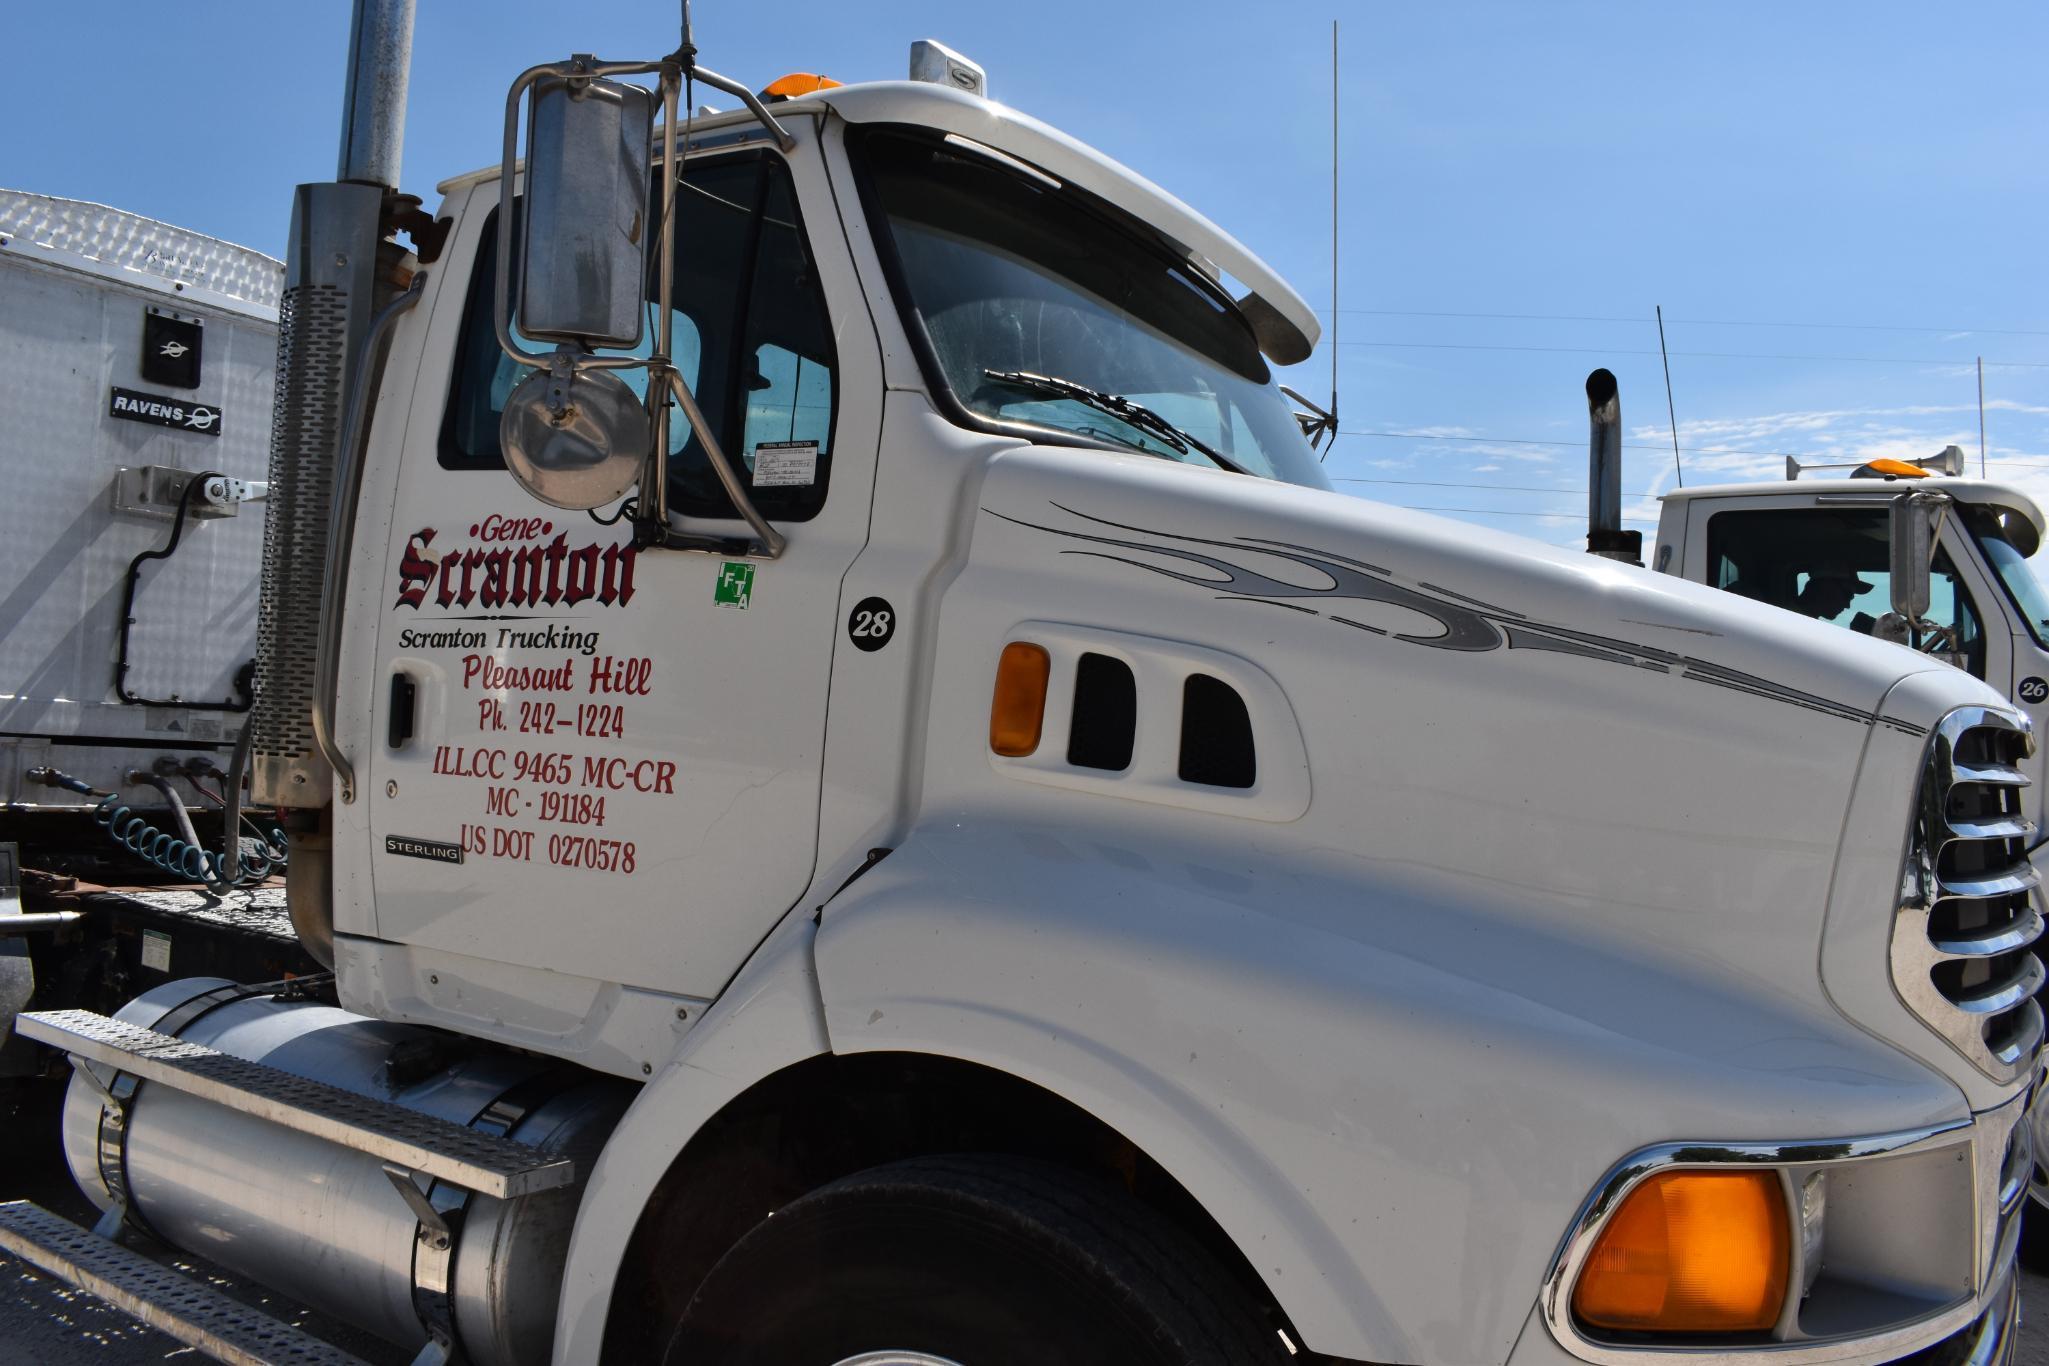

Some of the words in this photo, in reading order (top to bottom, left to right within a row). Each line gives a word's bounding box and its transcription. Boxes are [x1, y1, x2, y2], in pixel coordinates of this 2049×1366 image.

[114, 396, 184, 421] RAVENS
[480, 514, 544, 543] Gene
[393, 527, 641, 611] Scranton
[399, 627, 487, 649] Scranton
[497, 624, 600, 656] Trucking
[852, 610, 891, 638] 28
[462, 654, 574, 692] Pleasant
[589, 656, 652, 695] Hill
[2021, 682, 2046, 697] 26
[478, 698, 507, 731] Ph.
[519, 701, 624, 739] 242-1224
[513, 750, 574, 785] 9465
[581, 756, 677, 794] MC-CR
[486, 786, 520, 817] MC
[538, 791, 606, 827] 191184
[387, 839, 458, 859] STERLING
[460, 824, 487, 855] US
[492, 828, 535, 861] DOT
[548, 834, 636, 874] 0270578
